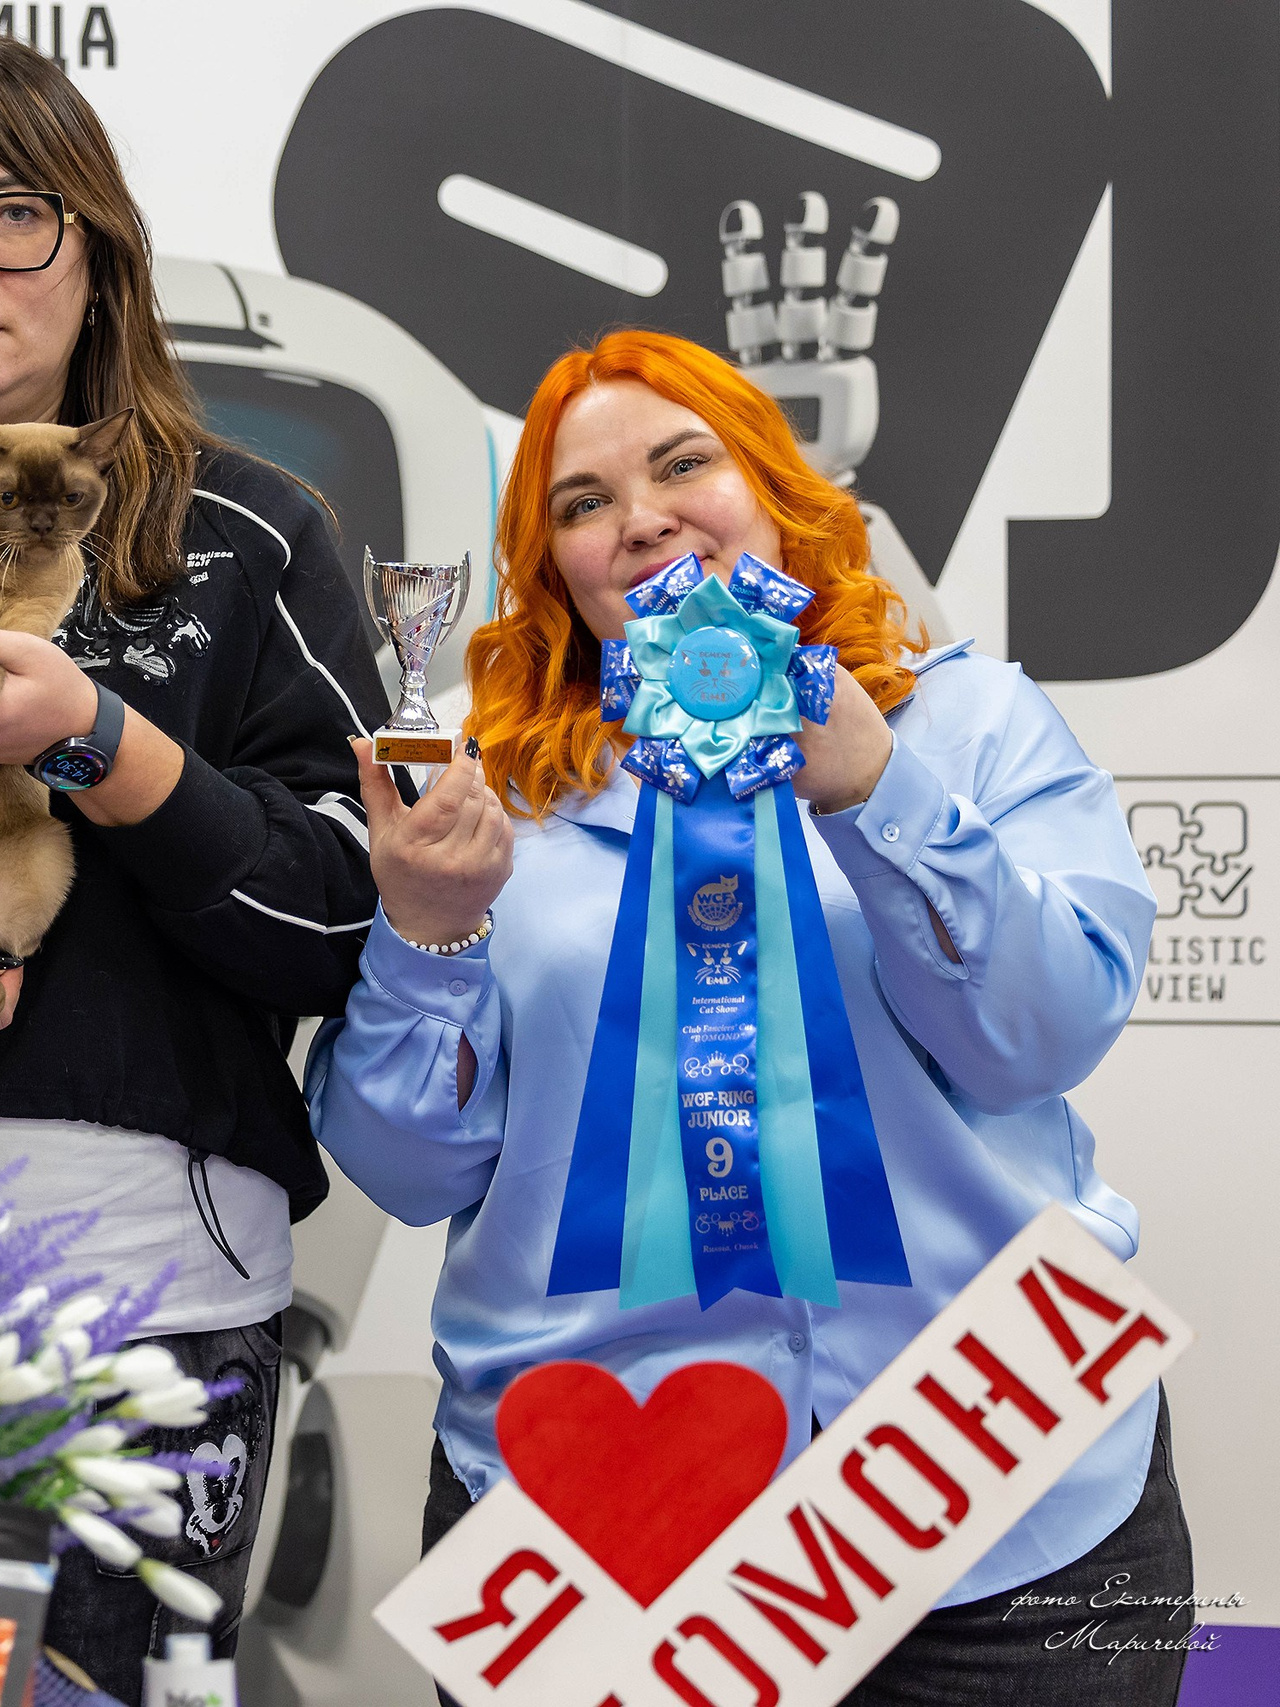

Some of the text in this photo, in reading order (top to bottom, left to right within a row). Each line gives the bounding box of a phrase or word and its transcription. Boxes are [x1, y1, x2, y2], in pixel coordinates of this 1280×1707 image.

[56, 760, 89, 782] 14:30
[696, 891, 733, 905] WCF
[1147, 974, 1227, 1003] VIEW
[692, 995, 745, 1005] International
[699, 1005, 738, 1014] Cat Show
[682, 1025, 701, 1034] Club
[739, 1023, 754, 1031] Cat
[681, 1089, 755, 1108] WCF-RING
[688, 1109, 751, 1129] JUNIOR
[705, 1137, 734, 1178] 9
[699, 1185, 749, 1201] PLACE
[591, 1255, 1170, 1707] ОМОНД
[433, 1546, 586, 1690] Я
